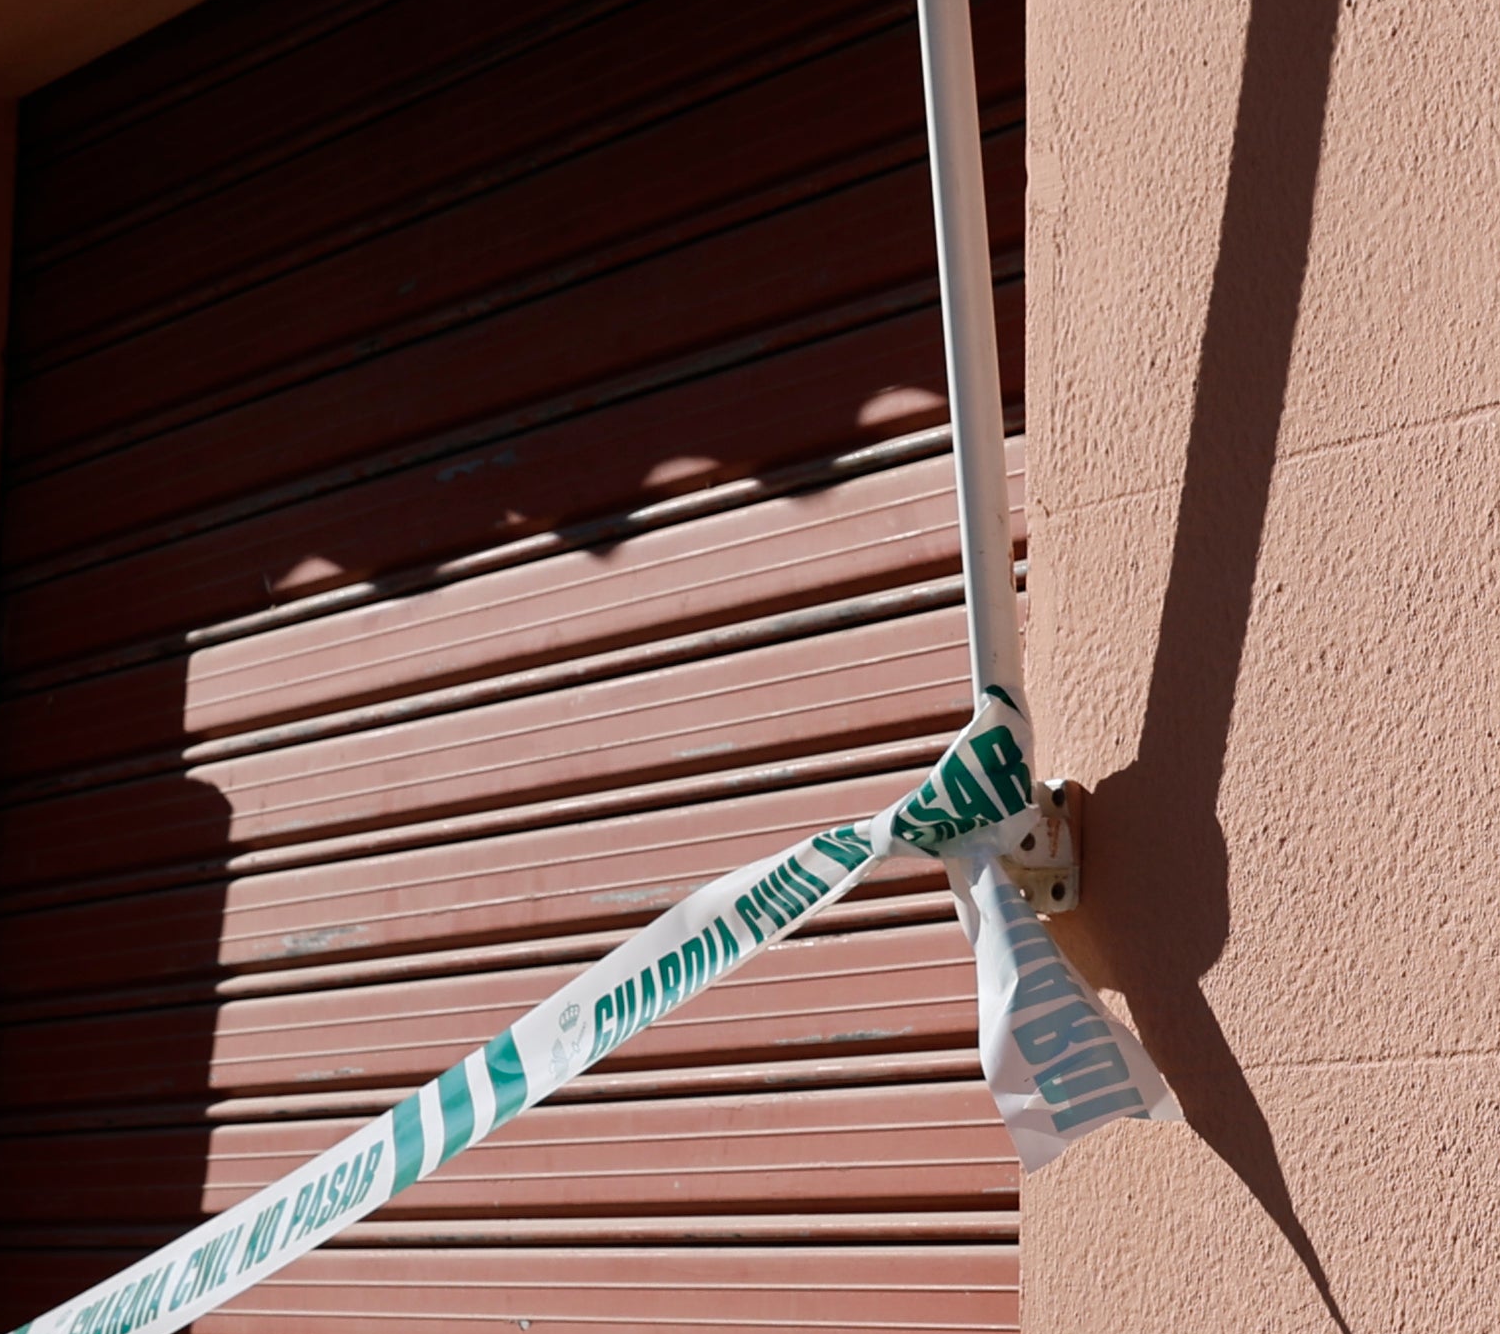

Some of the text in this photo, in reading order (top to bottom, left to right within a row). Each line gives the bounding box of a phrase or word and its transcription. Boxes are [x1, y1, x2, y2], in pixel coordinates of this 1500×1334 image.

[168, 1229, 235, 1313] CIVIL
[238, 1192, 282, 1273] NO
[281, 1137, 387, 1244] PASAR
[586, 914, 741, 1065] GUARDIA
